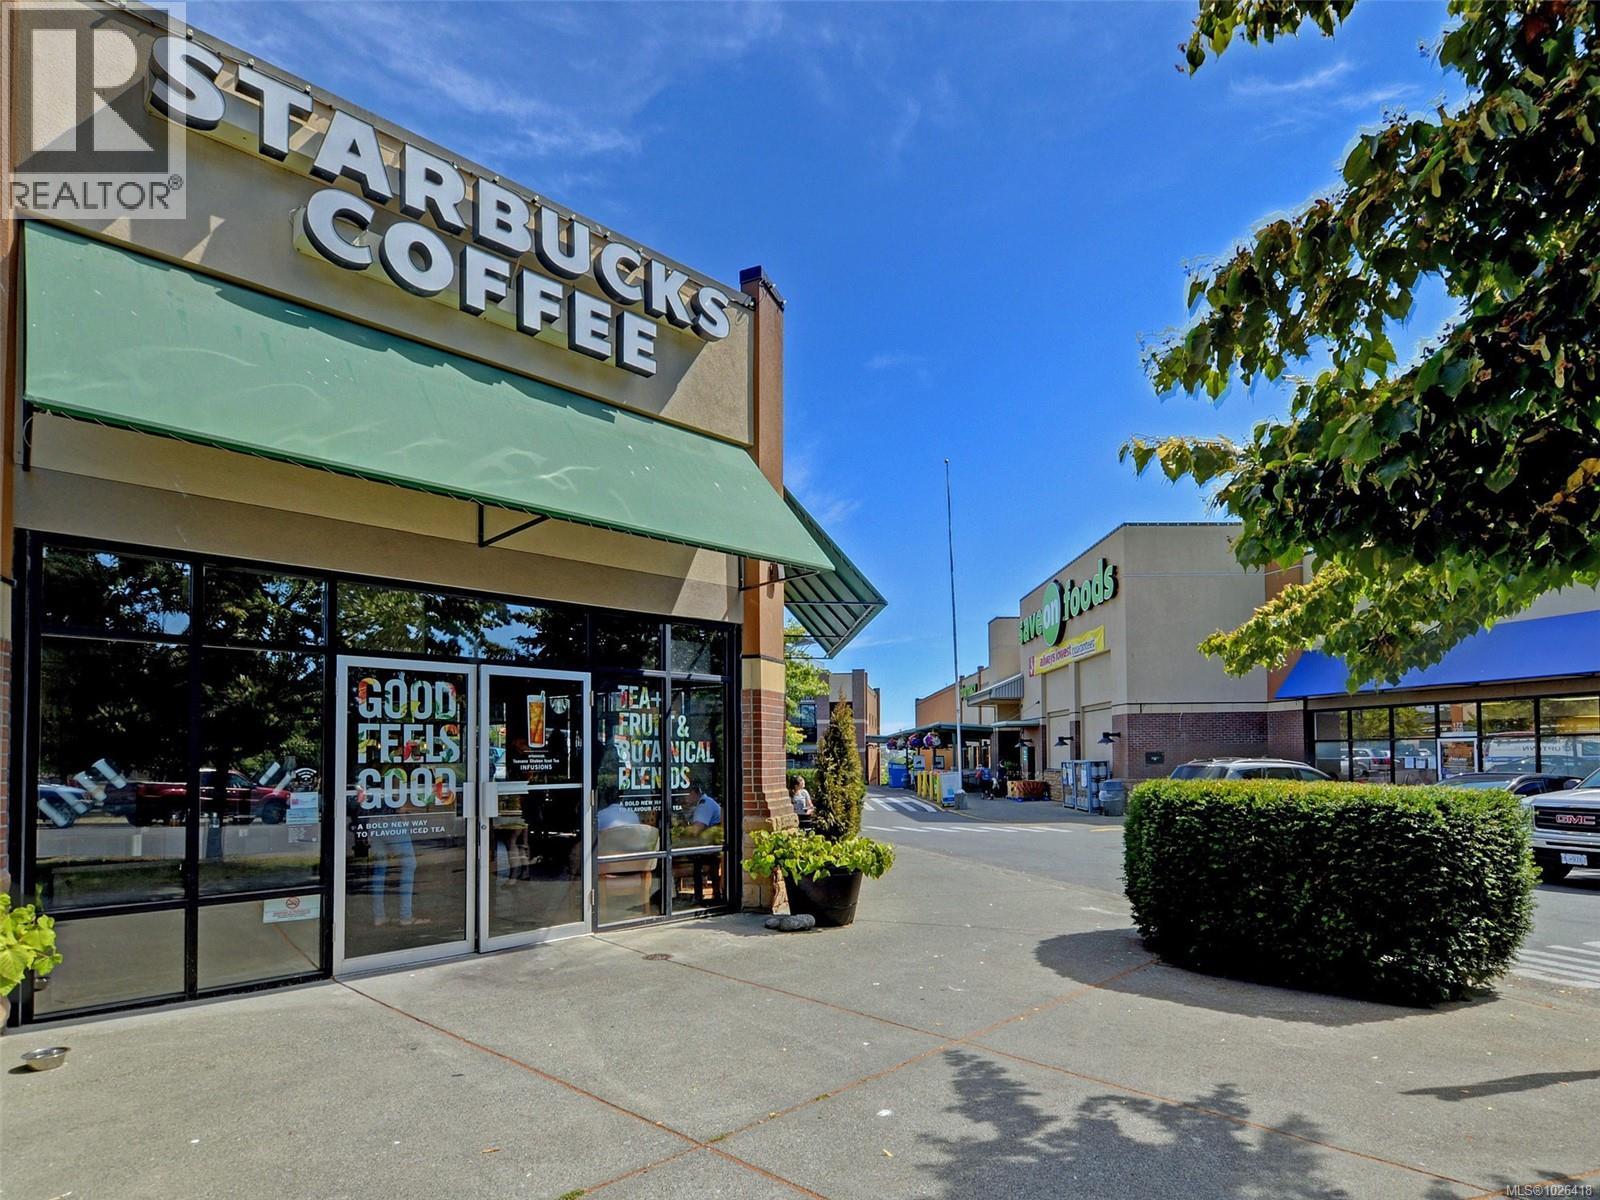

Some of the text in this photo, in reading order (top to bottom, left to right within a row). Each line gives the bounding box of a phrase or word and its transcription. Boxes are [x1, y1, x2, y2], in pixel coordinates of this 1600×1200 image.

[149, 35, 731, 343] STARBUCKS
[303, 188, 658, 377] COFFEE
[1043, 599, 1060, 629] on
[1063, 558, 1114, 621] foods
[358, 677, 457, 720] GOOD
[358, 723, 460, 764] FEELS
[677, 715, 690, 738] &
[618, 738, 715, 763] BOTANICAL
[358, 768, 457, 809] GOOD
[618, 766, 690, 790] BLENDS
[370, 829, 407, 837] FLAVOUR
[1556, 814, 1596, 825] GMC
